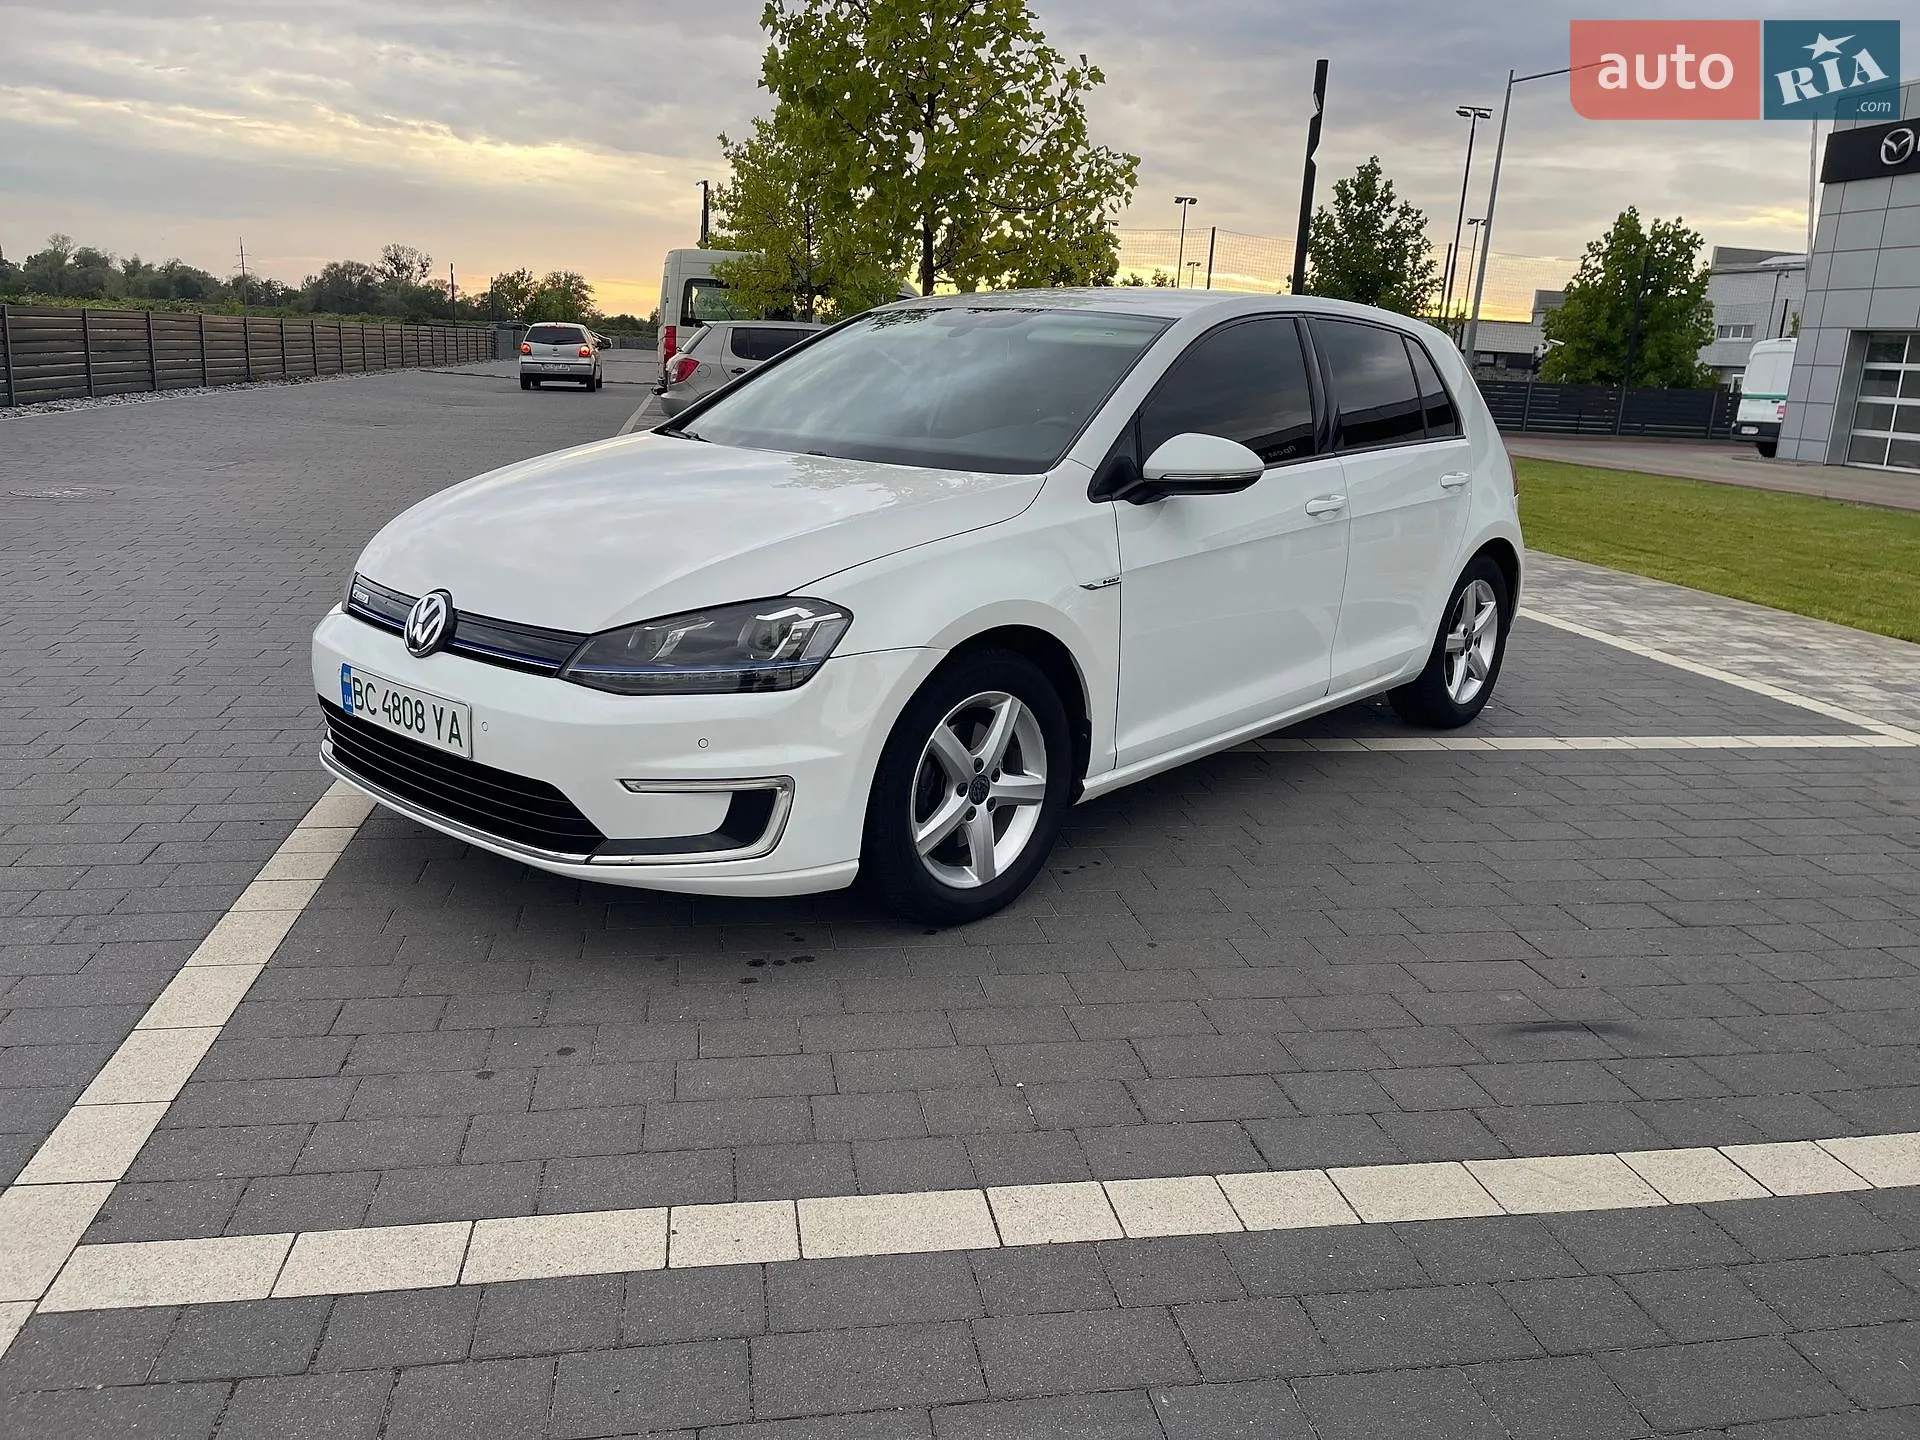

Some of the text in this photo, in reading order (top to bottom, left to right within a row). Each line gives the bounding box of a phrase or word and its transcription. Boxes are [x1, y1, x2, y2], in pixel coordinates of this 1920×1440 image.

[352, 677, 463, 748] BC 4808 YA
